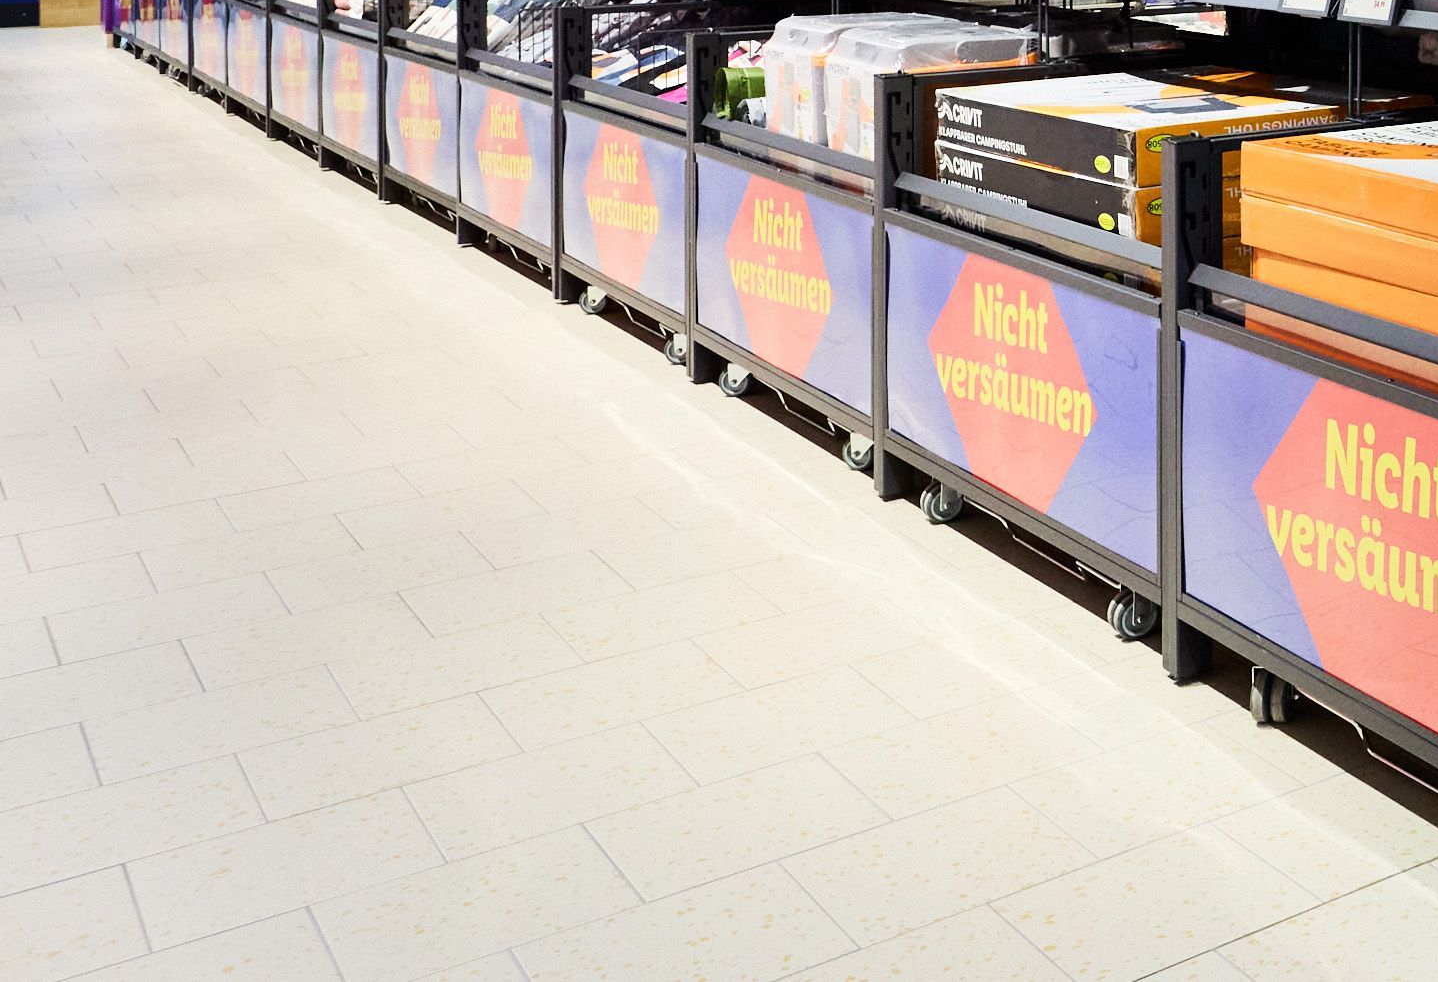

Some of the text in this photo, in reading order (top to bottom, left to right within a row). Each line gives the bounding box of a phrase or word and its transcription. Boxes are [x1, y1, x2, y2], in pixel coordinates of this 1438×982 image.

[939, 125, 1027, 156] KLAPPBARER CAMPINGSTUHL
[952, 105, 983, 128] CRIVIT
[603, 142, 639, 185] Nicht
[587, 189, 660, 235] versäumen
[753, 197, 804, 252] Nicht
[730, 257, 831, 316] versäumen
[973, 282, 1049, 355] Nicht
[936, 352, 1092, 437] versäumen
